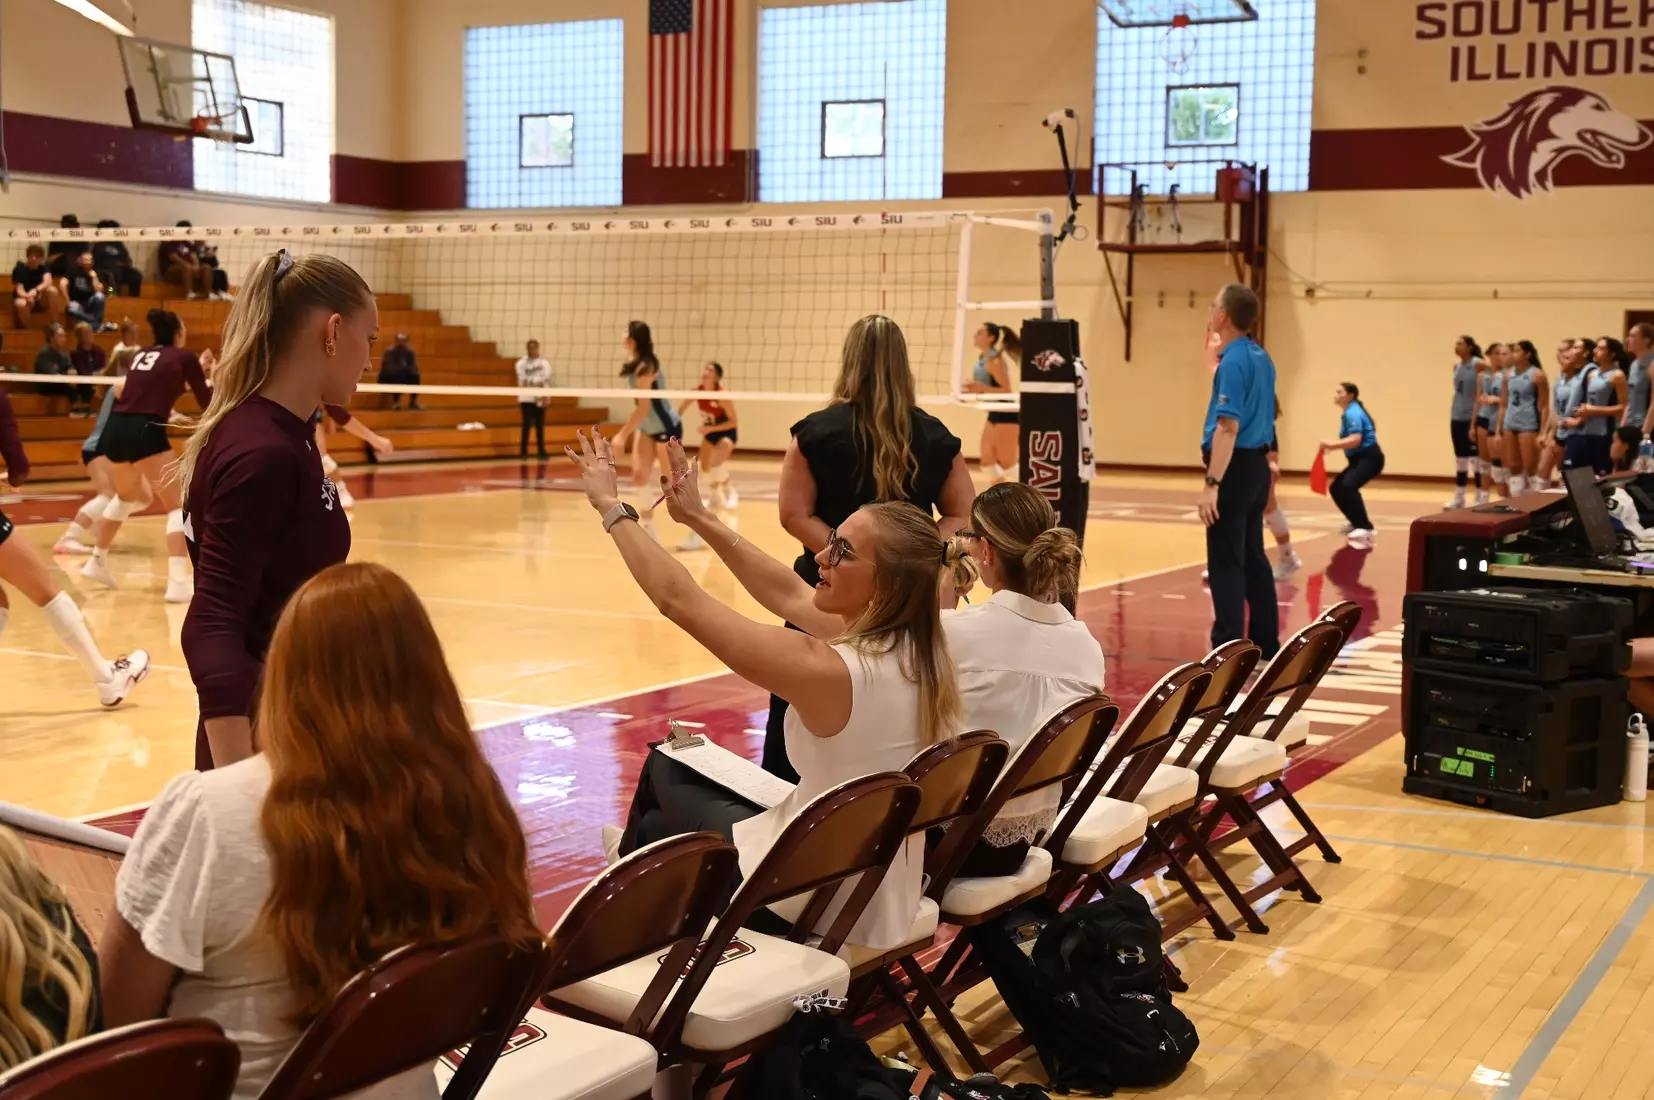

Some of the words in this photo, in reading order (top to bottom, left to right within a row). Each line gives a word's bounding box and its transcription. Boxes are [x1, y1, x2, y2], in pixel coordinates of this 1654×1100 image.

[629, 220, 649, 230] SIU
[689, 219, 711, 229] SIU
[751, 218, 773, 228] SIU
[815, 216, 837, 226] SIU
[130, 351, 161, 371] 13
